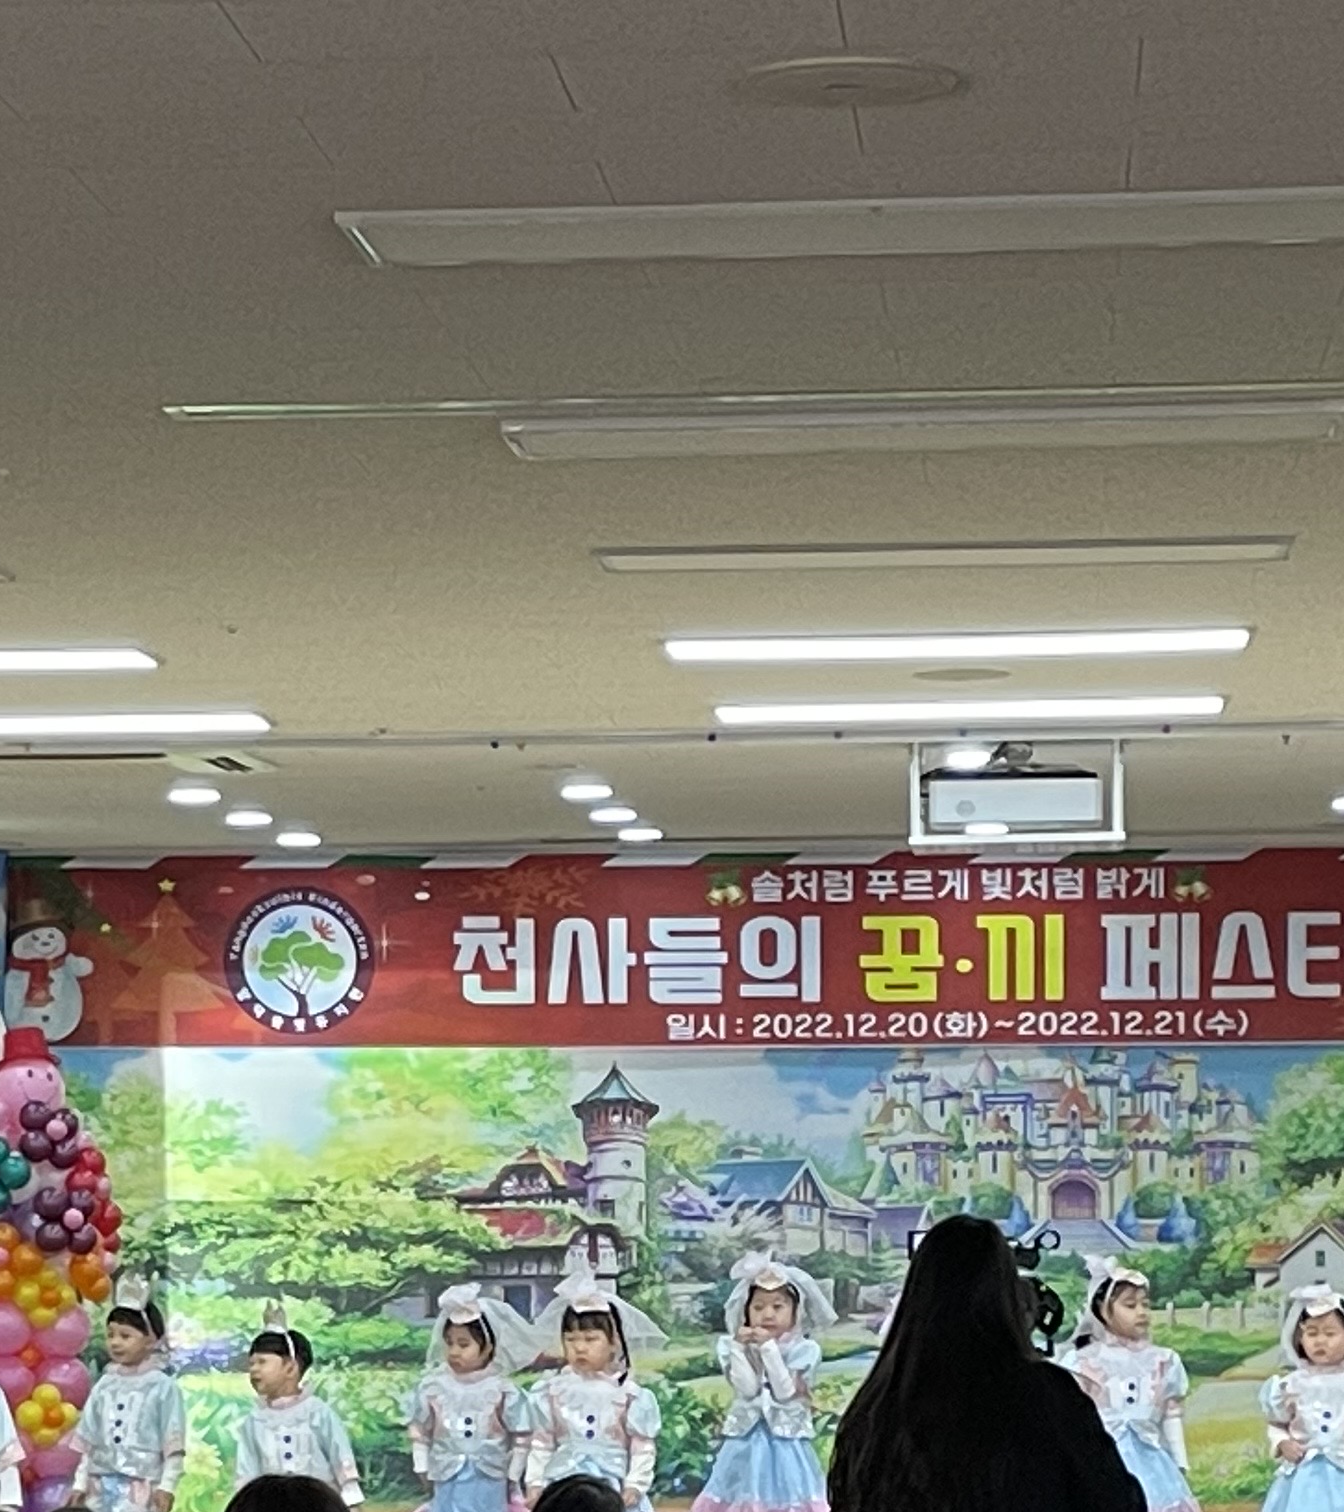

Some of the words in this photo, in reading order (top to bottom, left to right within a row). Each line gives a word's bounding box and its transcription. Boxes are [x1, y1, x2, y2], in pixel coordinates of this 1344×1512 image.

[751, 869, 854, 902] 솔처럼
[865, 868, 970, 901] 푸르게
[980, 867, 1084, 900] 빛처럼
[1096, 866, 1165, 899] 밝게
[453, 915, 821, 1005] 천사들의
[665, 1013, 726, 1041] 일시
